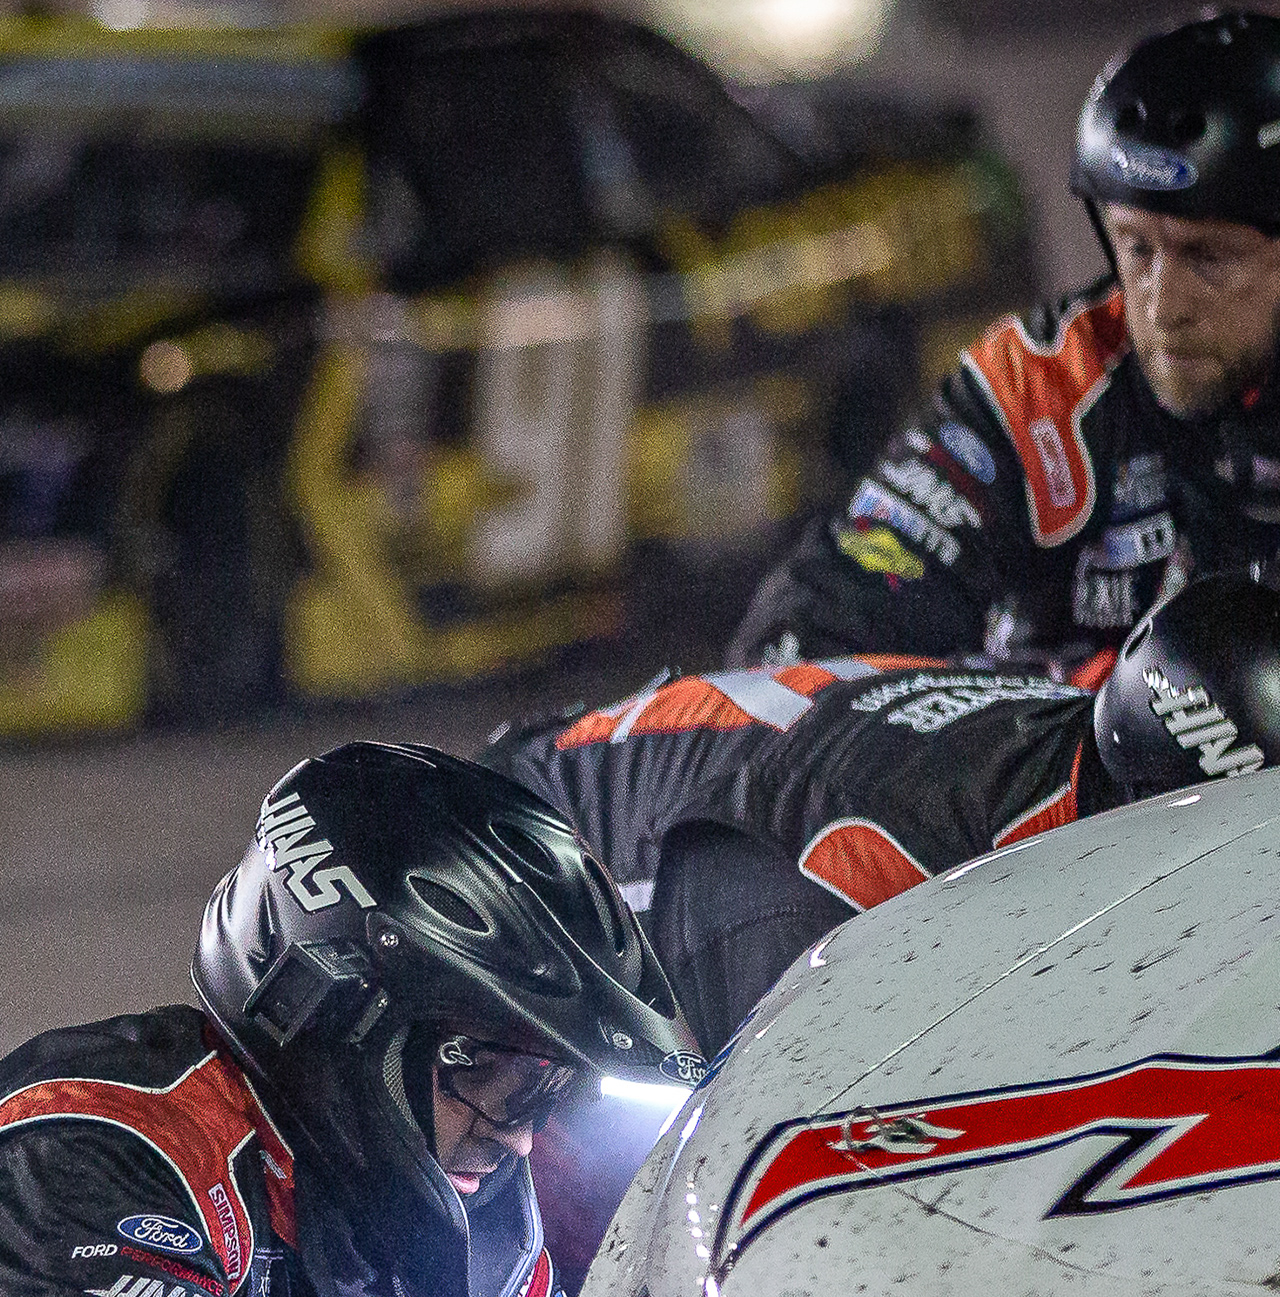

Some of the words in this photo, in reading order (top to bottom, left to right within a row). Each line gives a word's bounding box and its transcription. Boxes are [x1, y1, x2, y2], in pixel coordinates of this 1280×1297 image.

[261, 792, 378, 912] HAAS
[134, 1217, 190, 1248] Ford
[72, 1244, 118, 1259] FORD
